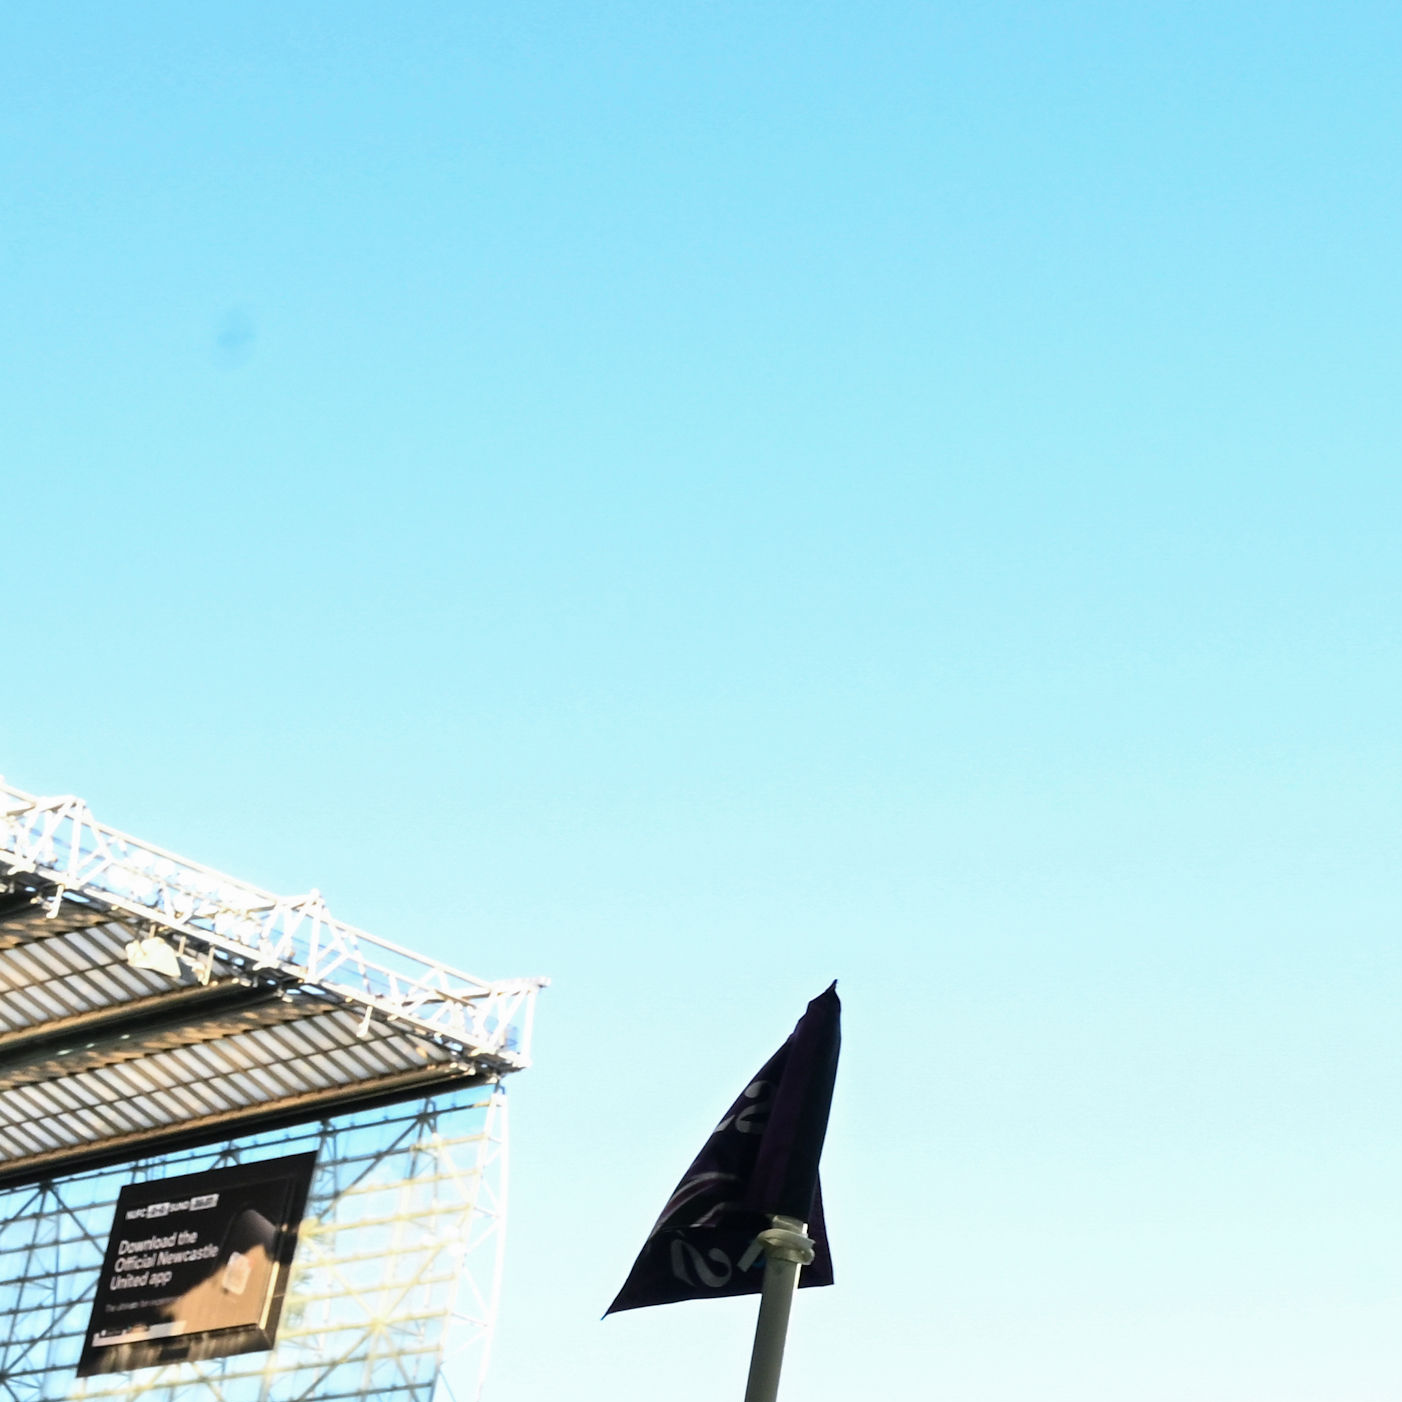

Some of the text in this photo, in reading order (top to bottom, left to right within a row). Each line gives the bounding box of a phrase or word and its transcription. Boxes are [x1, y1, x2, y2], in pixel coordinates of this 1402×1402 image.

[118, 1229, 198, 1255] Download the
[115, 1243, 219, 1272] Official Newcastle
[110, 1270, 173, 1290] United app
